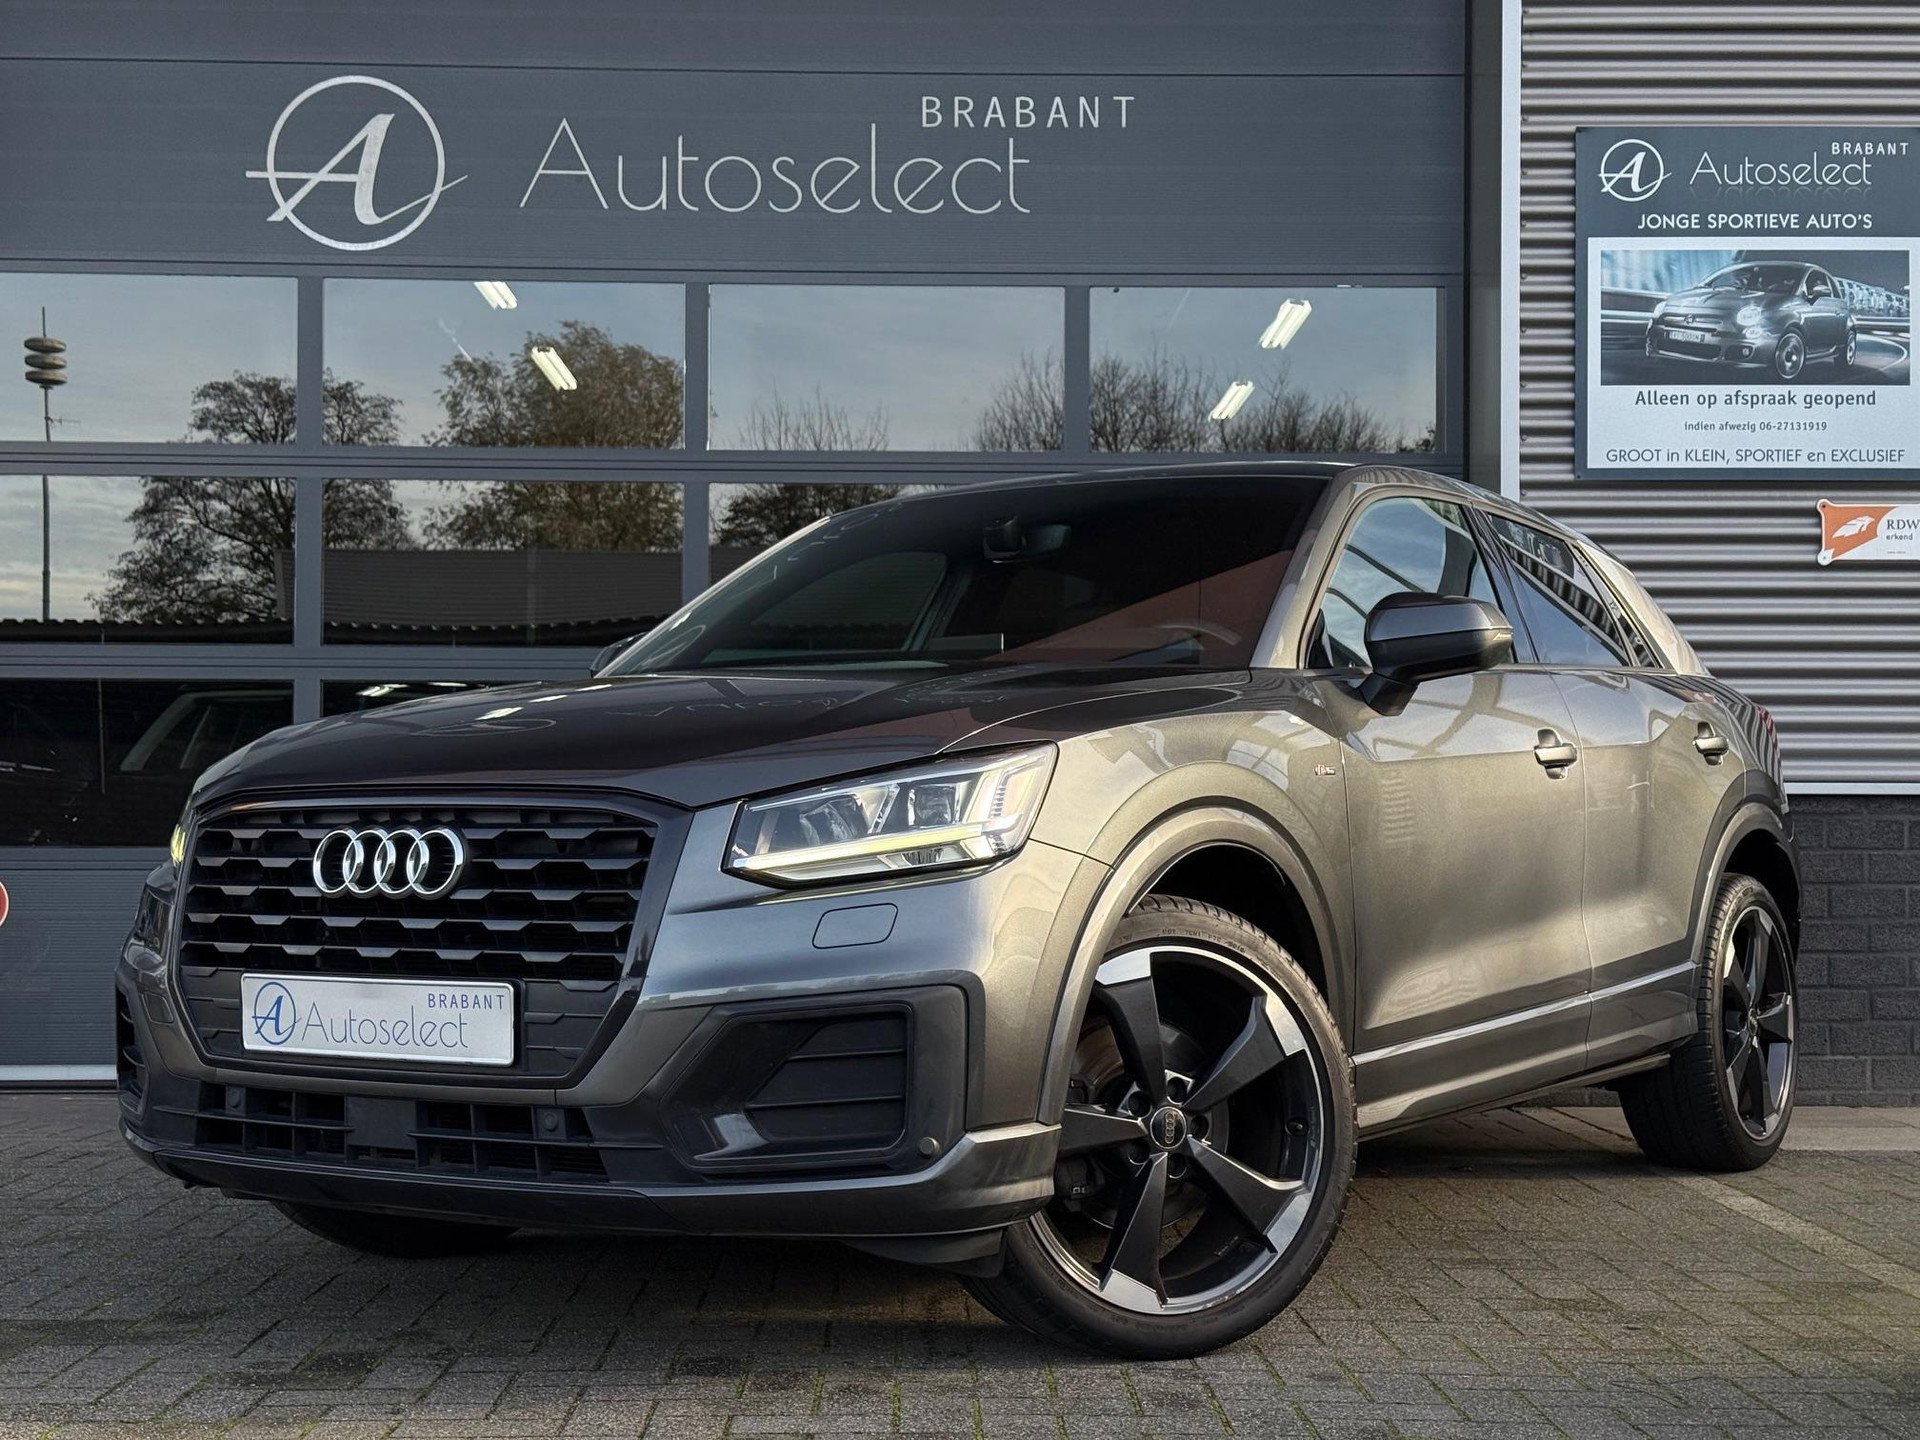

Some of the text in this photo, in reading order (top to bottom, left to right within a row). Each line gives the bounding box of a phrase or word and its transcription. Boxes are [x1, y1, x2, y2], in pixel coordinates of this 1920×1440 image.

[921, 95, 1136, 129] BRABANT
[1831, 142, 1909, 156] BRABANT
[519, 117, 1031, 214] Autoselect
[1689, 151, 1872, 185] Autoselect
[1637, 213, 1873, 229] JONGE SPORTIEVE AUTO'S
[1634, 390, 1876, 410] Alleen op afspraak geopend
[1684, 421, 1828, 433] indien afwezig 06-27131919
[1606, 448, 1906, 465] GROOT in KLEIN, SPORTIEF en EXCLUSIEF
[1886, 519, 1920, 530] RDW
[1886, 532, 1913, 541] erkend
[427, 993, 505, 1010] BRABANT
[301, 1001, 469, 1048] Autoselect
